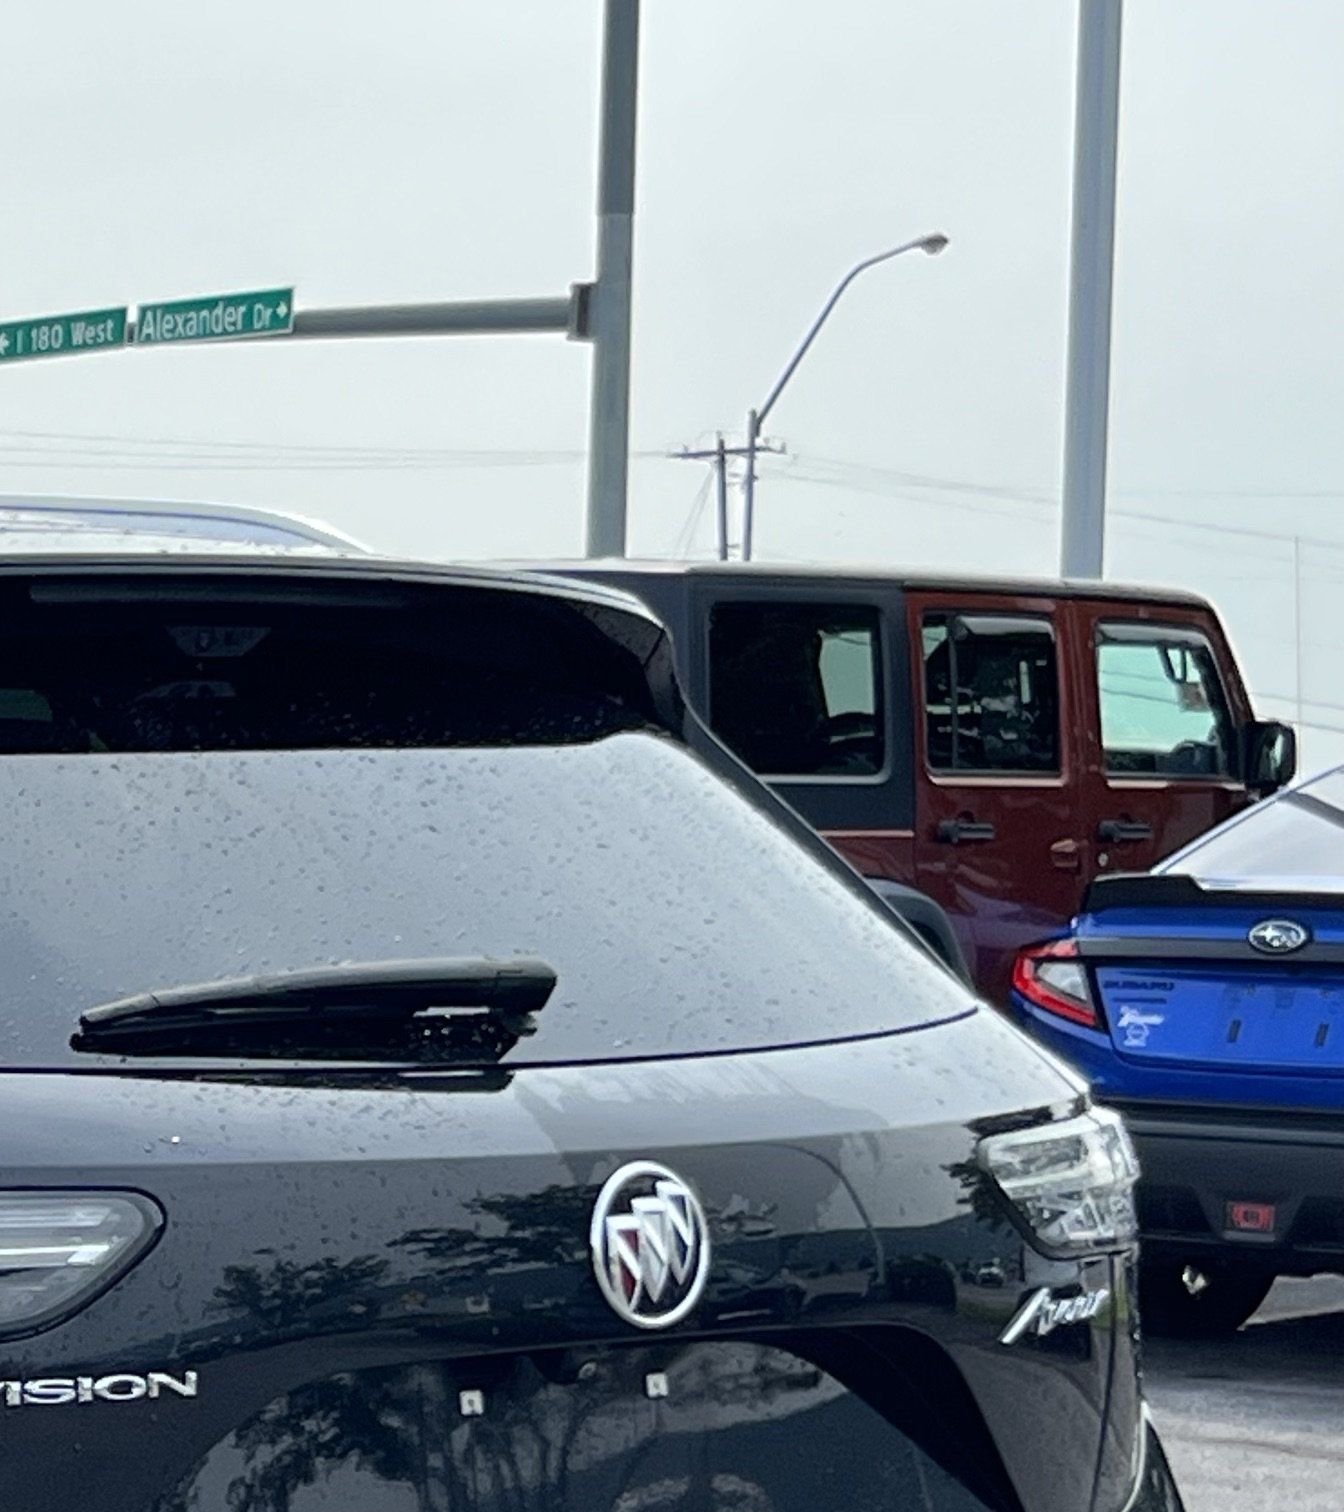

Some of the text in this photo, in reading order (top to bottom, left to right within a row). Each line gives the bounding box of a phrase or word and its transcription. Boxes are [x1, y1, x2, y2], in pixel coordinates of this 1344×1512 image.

[16, 318, 114, 353] I 180 West
[140, 300, 274, 342] Alexander Dr
